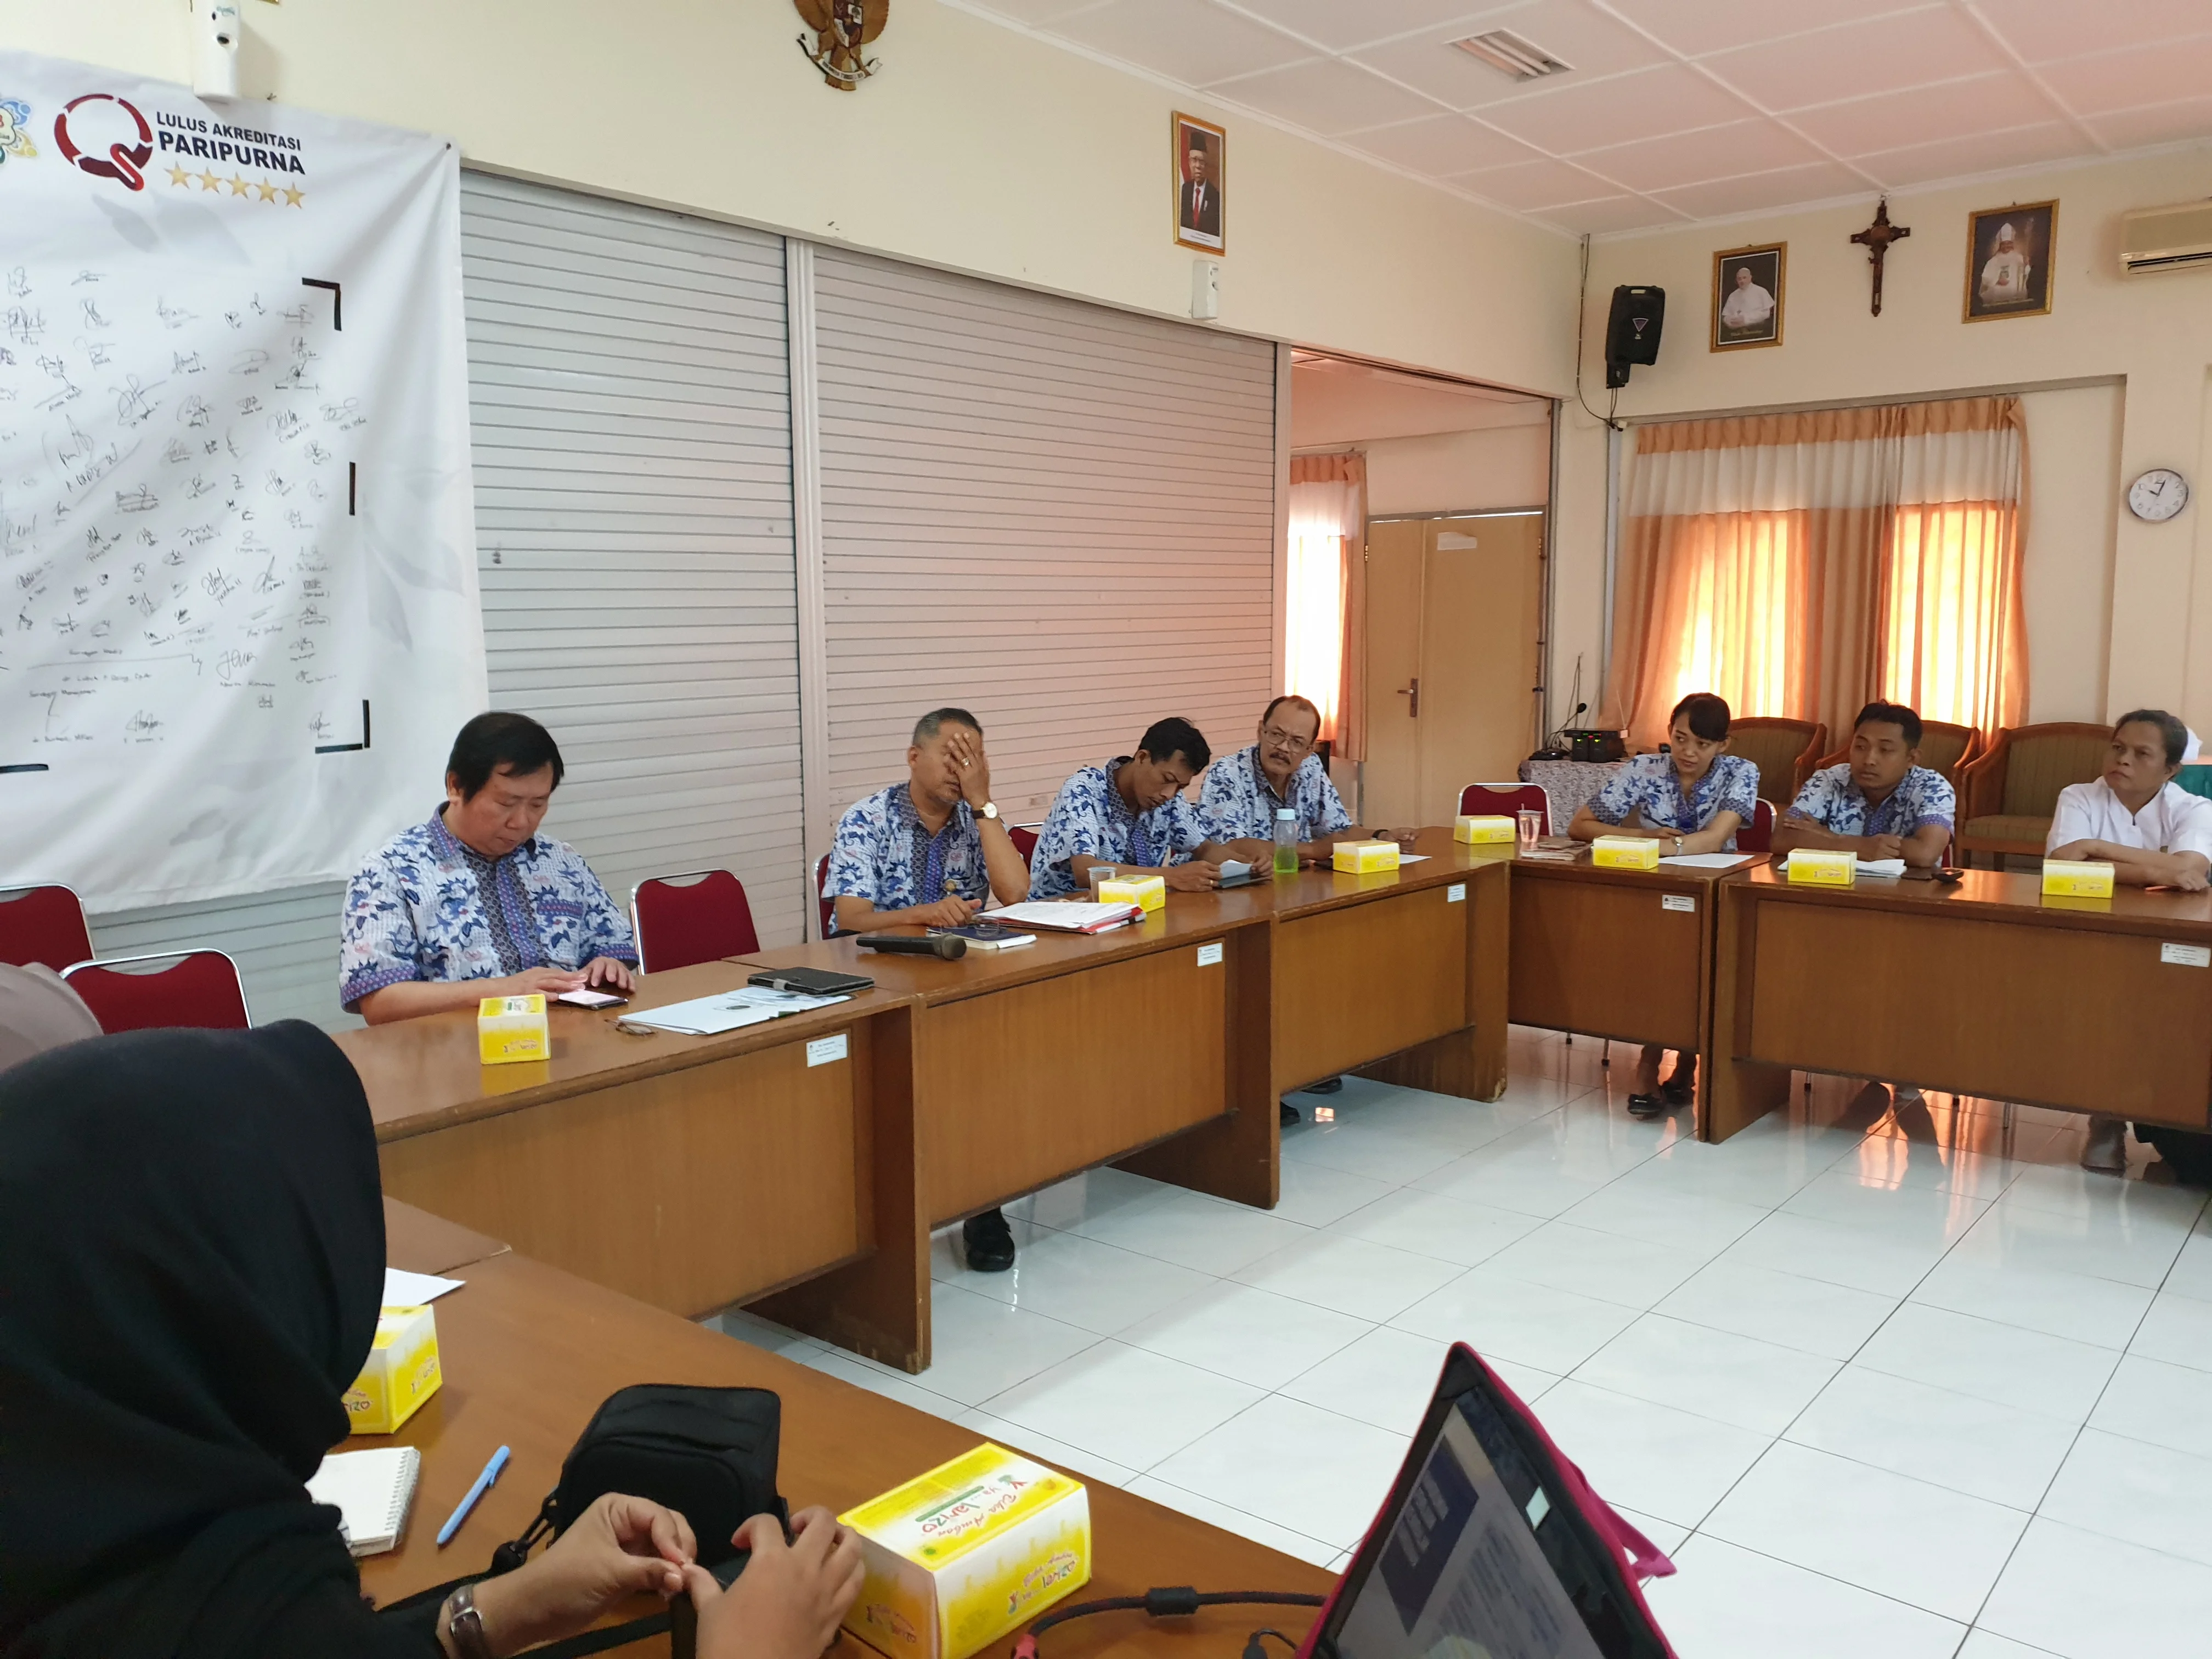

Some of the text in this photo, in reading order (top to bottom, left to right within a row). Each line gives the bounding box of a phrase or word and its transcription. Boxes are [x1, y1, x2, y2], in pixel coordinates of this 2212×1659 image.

[156, 111, 301, 151] LULUS AKREDITASI
[158, 130, 306, 176] PARIPURNA
